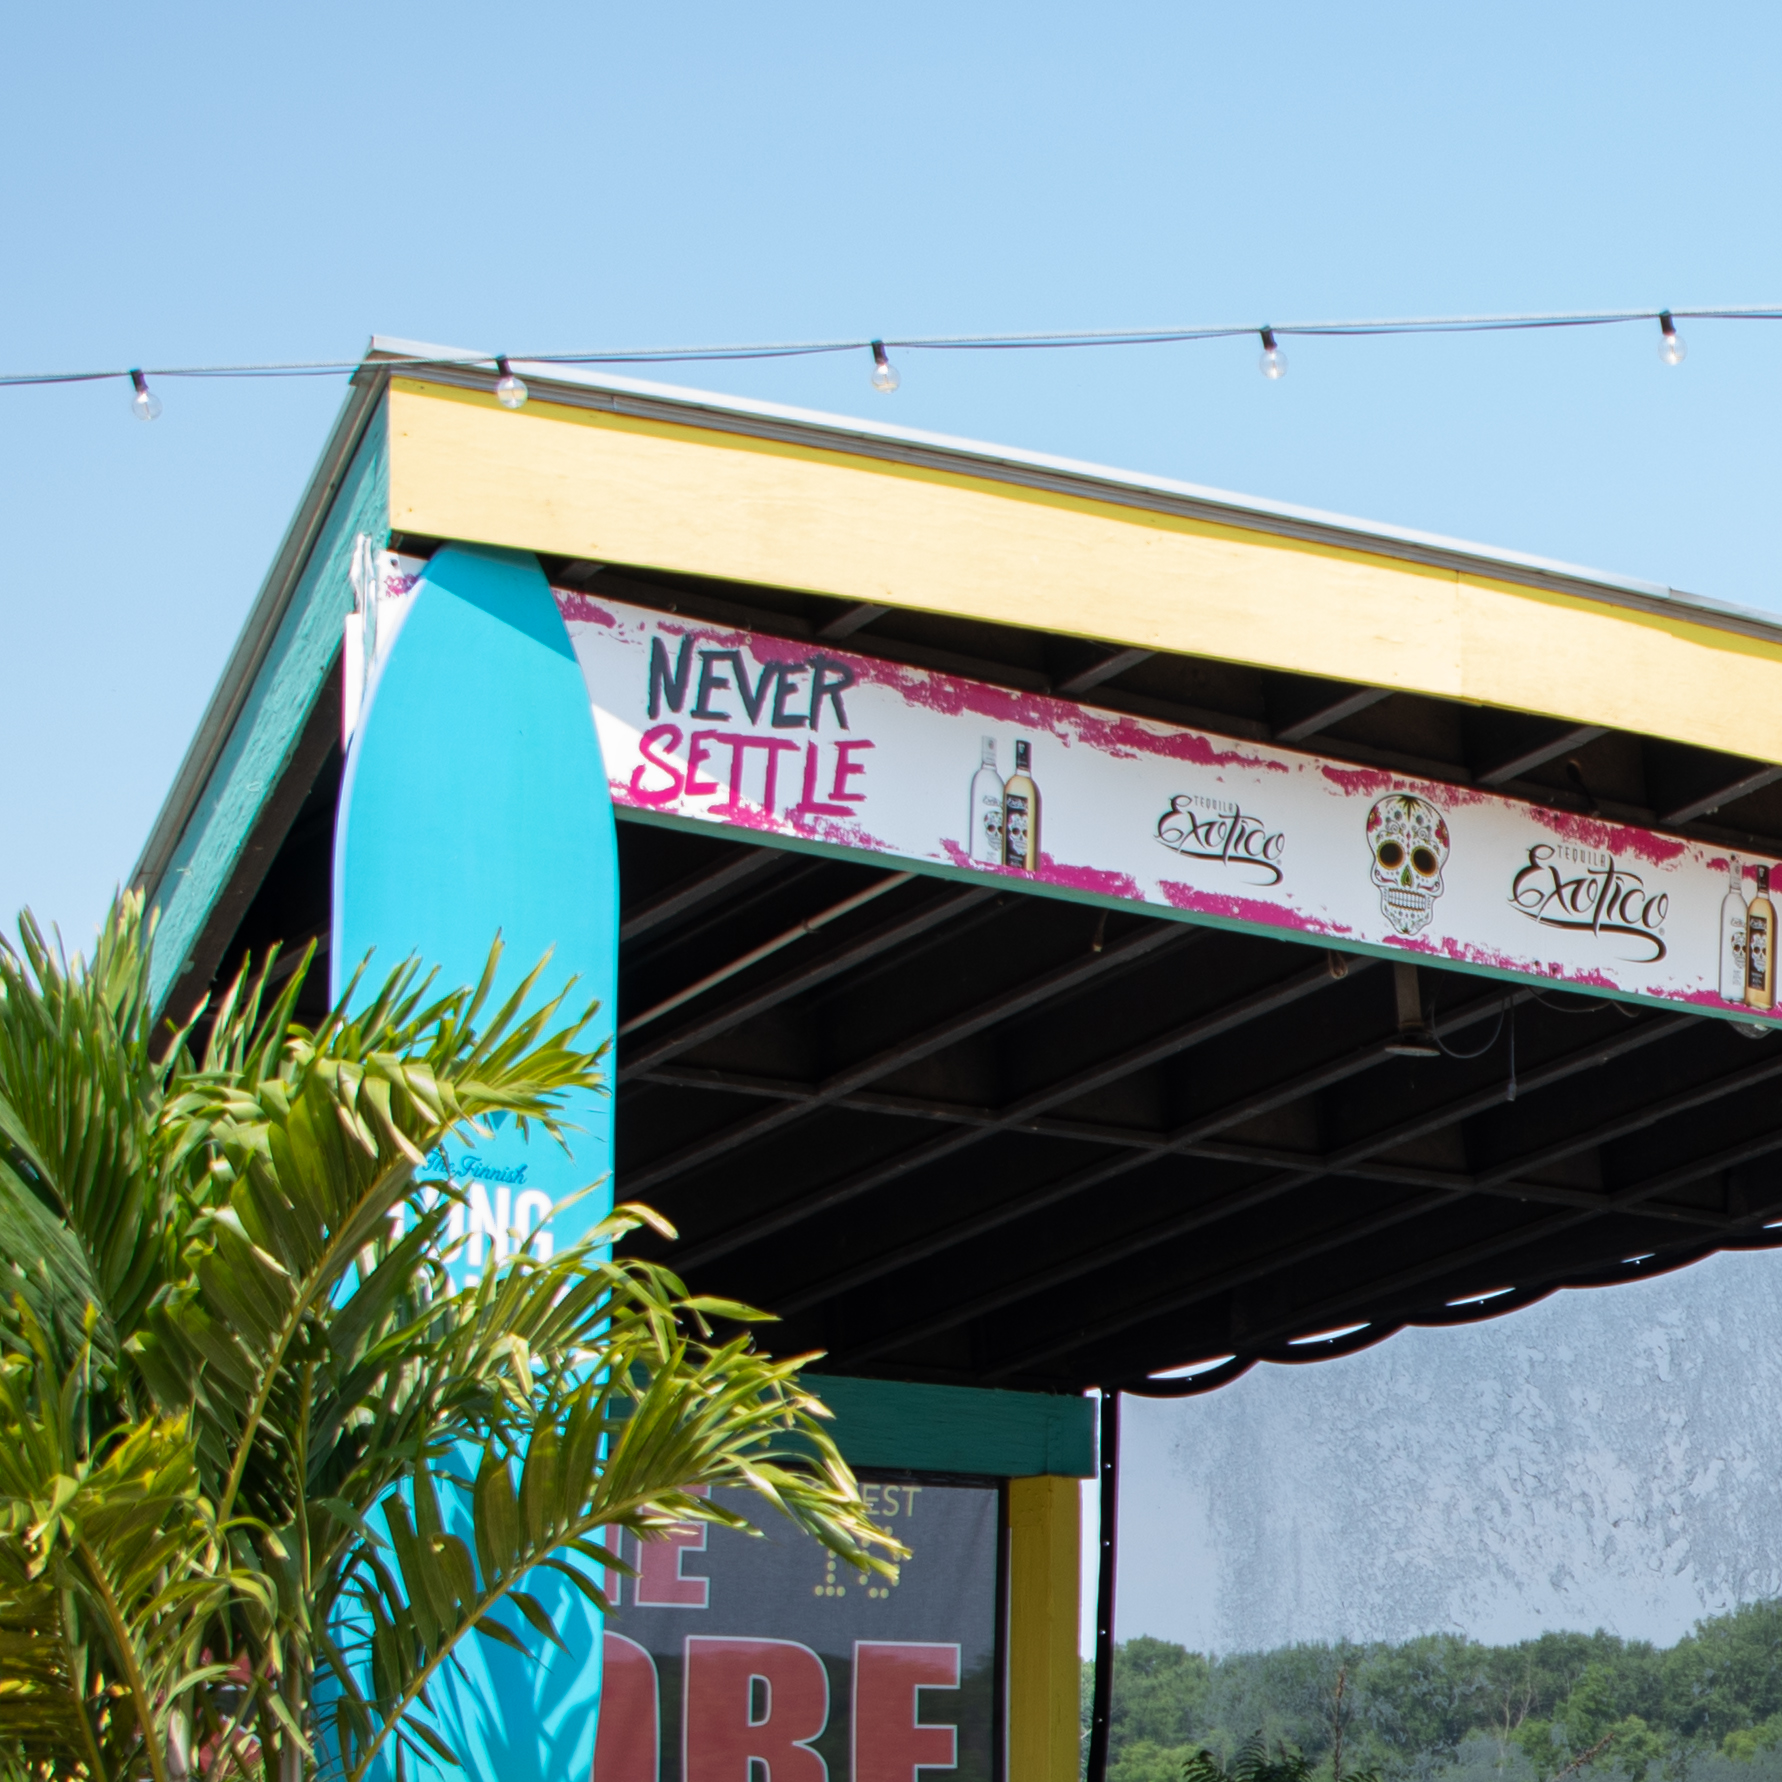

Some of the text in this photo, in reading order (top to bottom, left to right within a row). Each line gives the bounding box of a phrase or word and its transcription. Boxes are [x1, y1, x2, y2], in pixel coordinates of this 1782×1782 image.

[647, 634, 856, 733] NEVER
[629, 723, 876, 818] SETTLE
[1153, 794, 1286, 886] Exotico
[1557, 844, 1606, 868] TEQUILA
[1506, 843, 1669, 963] Exotico
[456, 1155, 528, 1185] Finnish
